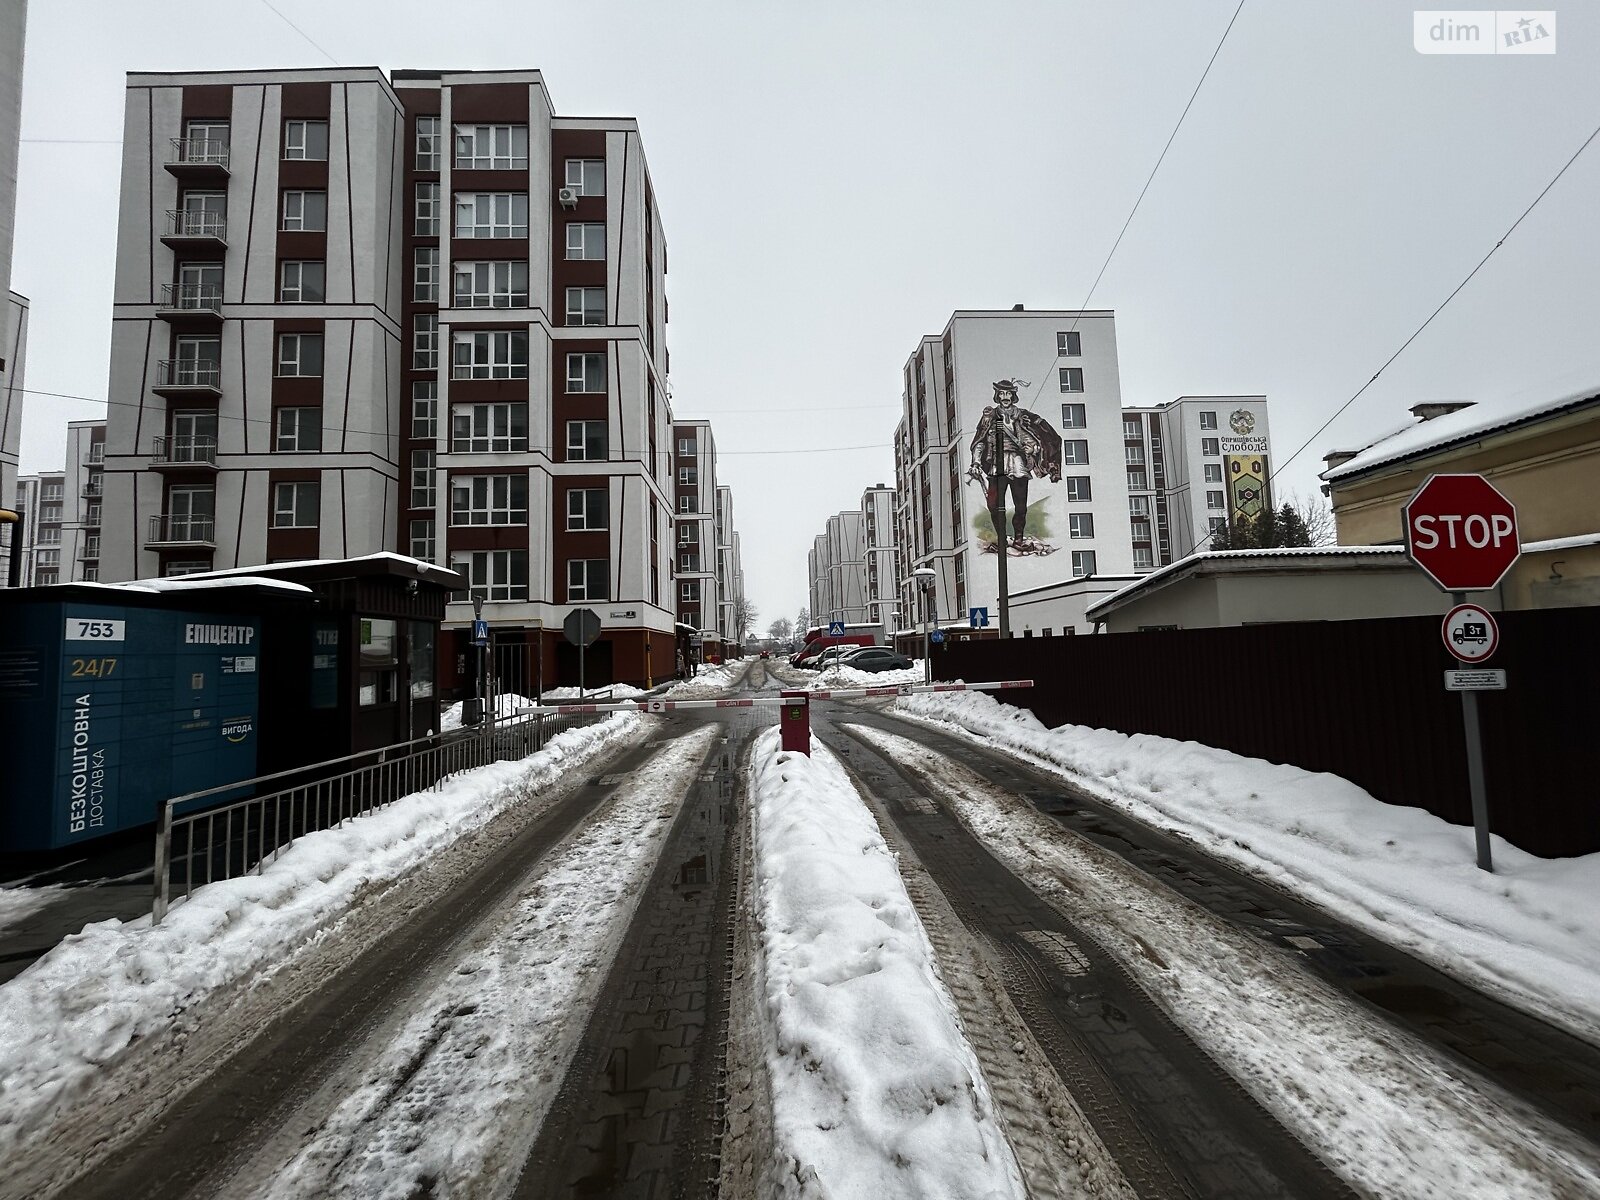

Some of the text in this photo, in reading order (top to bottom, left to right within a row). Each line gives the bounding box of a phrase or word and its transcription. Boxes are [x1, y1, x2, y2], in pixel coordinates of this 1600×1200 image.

[1414, 514, 1513, 550] STOP
[78, 622, 114, 637] 753
[185, 623, 254, 645] ЕПІЦЕНТР
[71, 658, 118, 677] 24/7
[222, 723, 253, 736] ВИГОДА
[70, 693, 90, 833] БЕЗКОШТОВНА
[89, 748, 105, 828] ДОСТАВКА
